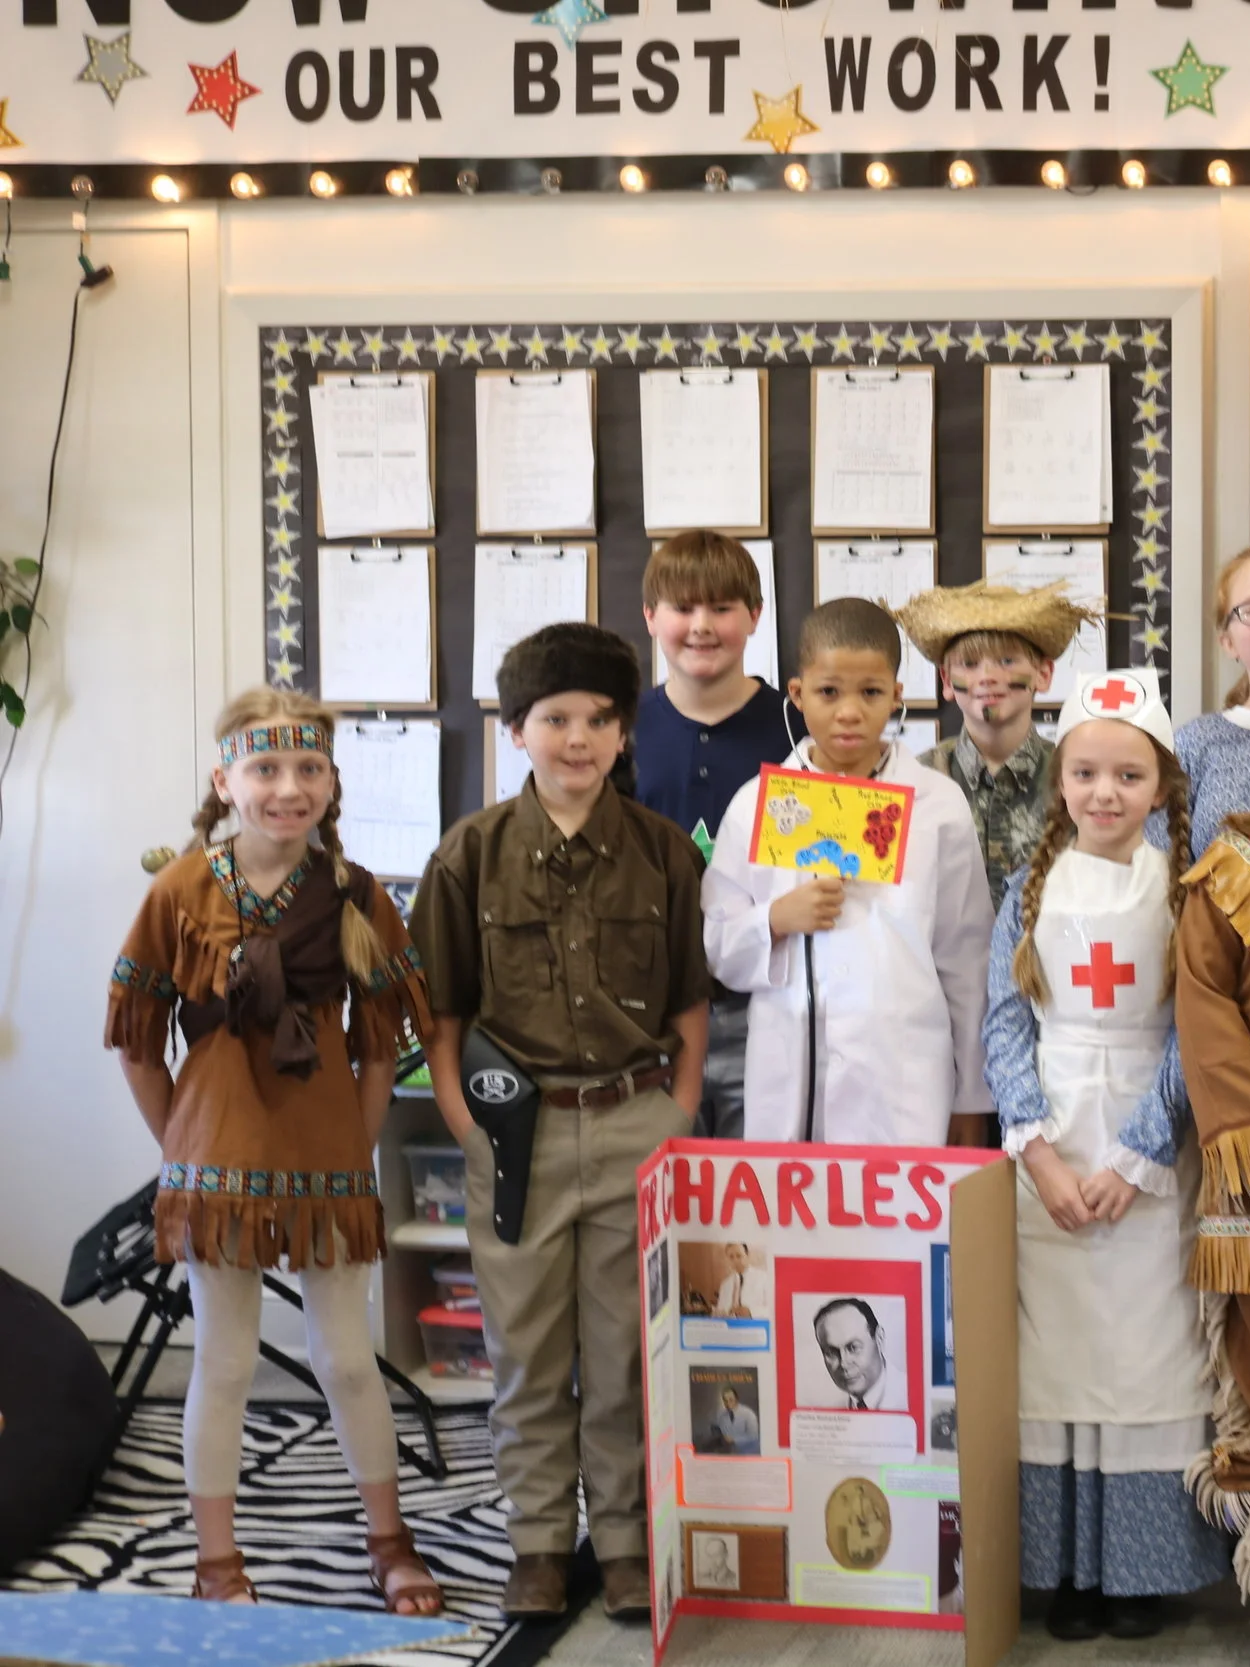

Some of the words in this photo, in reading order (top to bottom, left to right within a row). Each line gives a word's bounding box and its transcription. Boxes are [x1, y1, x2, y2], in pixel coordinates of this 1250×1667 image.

[285, 45, 442, 123] OUR
[512, 38, 740, 117] BEST
[825, 33, 1111, 113] WORK!
